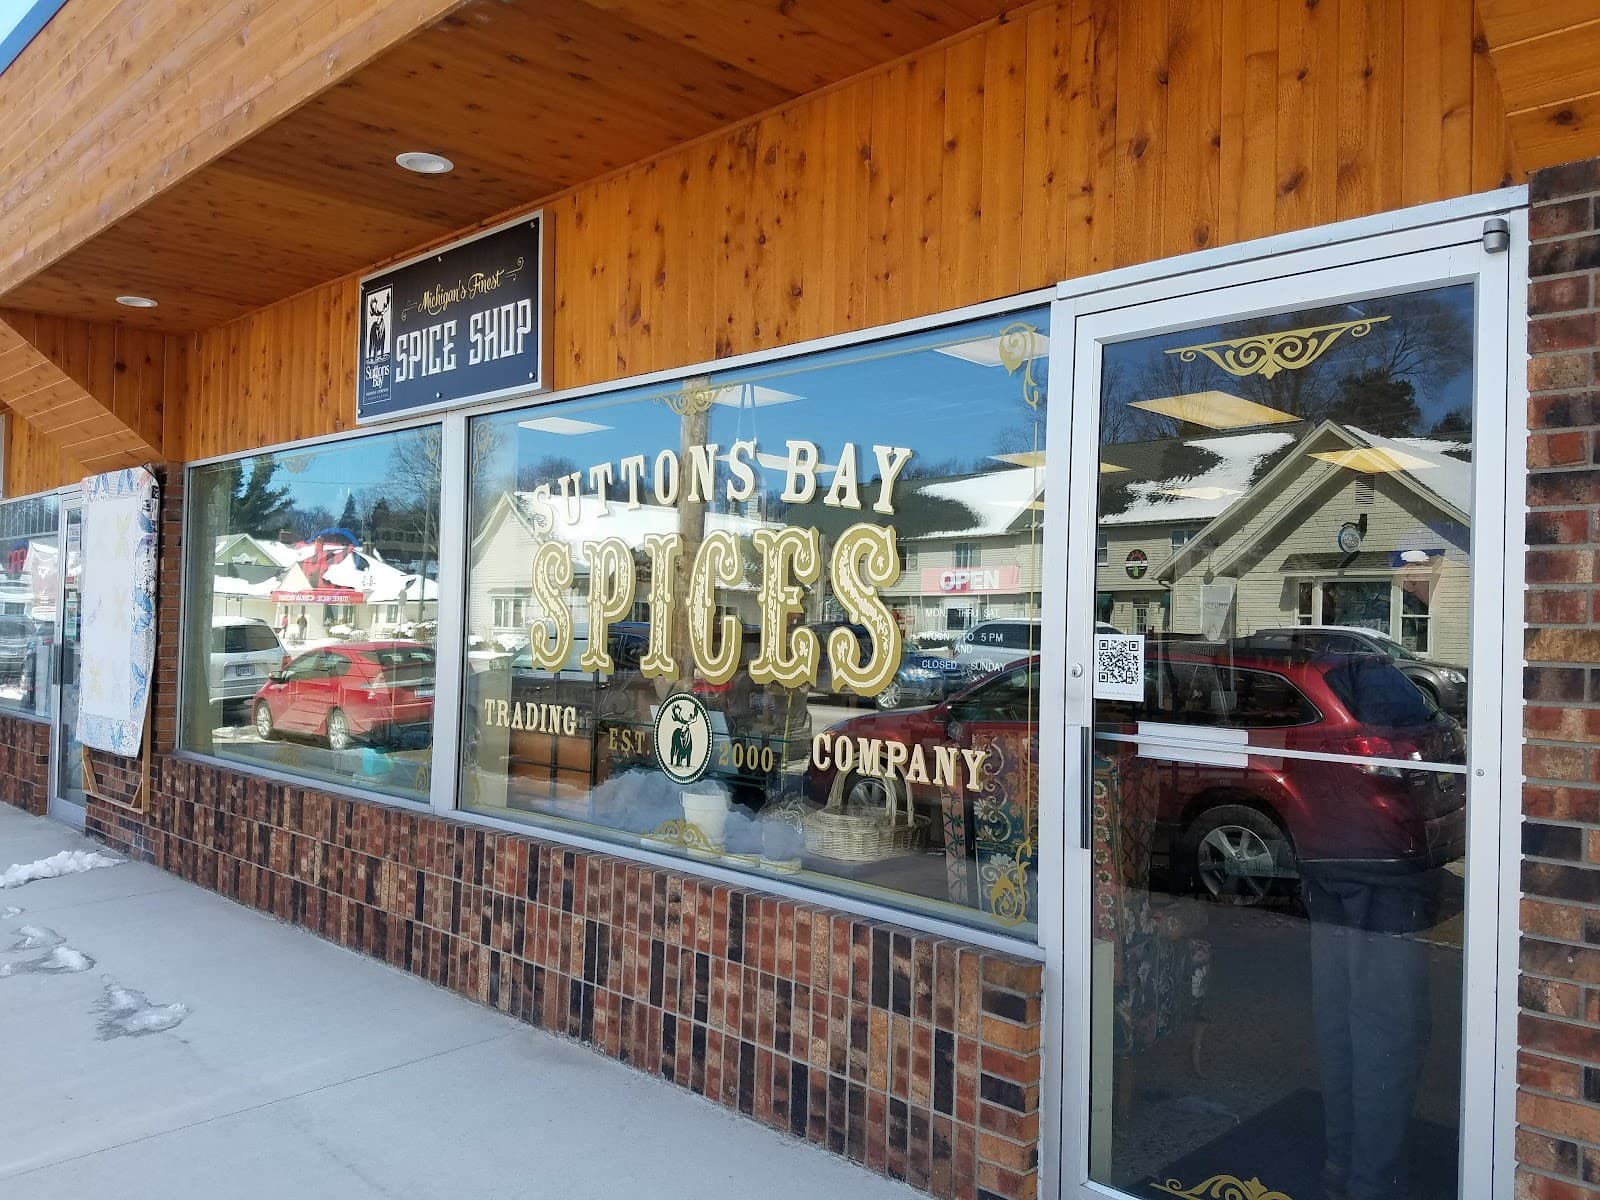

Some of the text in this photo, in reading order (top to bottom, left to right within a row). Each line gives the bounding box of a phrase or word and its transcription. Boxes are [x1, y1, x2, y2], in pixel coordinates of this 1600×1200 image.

[418, 268, 505, 315] Michigan's Finest
[394, 298, 532, 383] SPICE SHOP
[533, 439, 913, 536] SUTTONS BAY
[941, 570, 1000, 590] OPEN
[531, 522, 901, 697] SPICES
[954, 644, 973, 654] AND
[962, 632, 975, 642] TO
[981, 633, 987, 642] 5
[989, 633, 1003, 643] PM
[921, 660, 1006, 672] CLOSED SUNDAY
[484, 698, 578, 737] TRADING
[608, 727, 775, 774] EST. 2000
[812, 732, 987, 793] COMPANY
